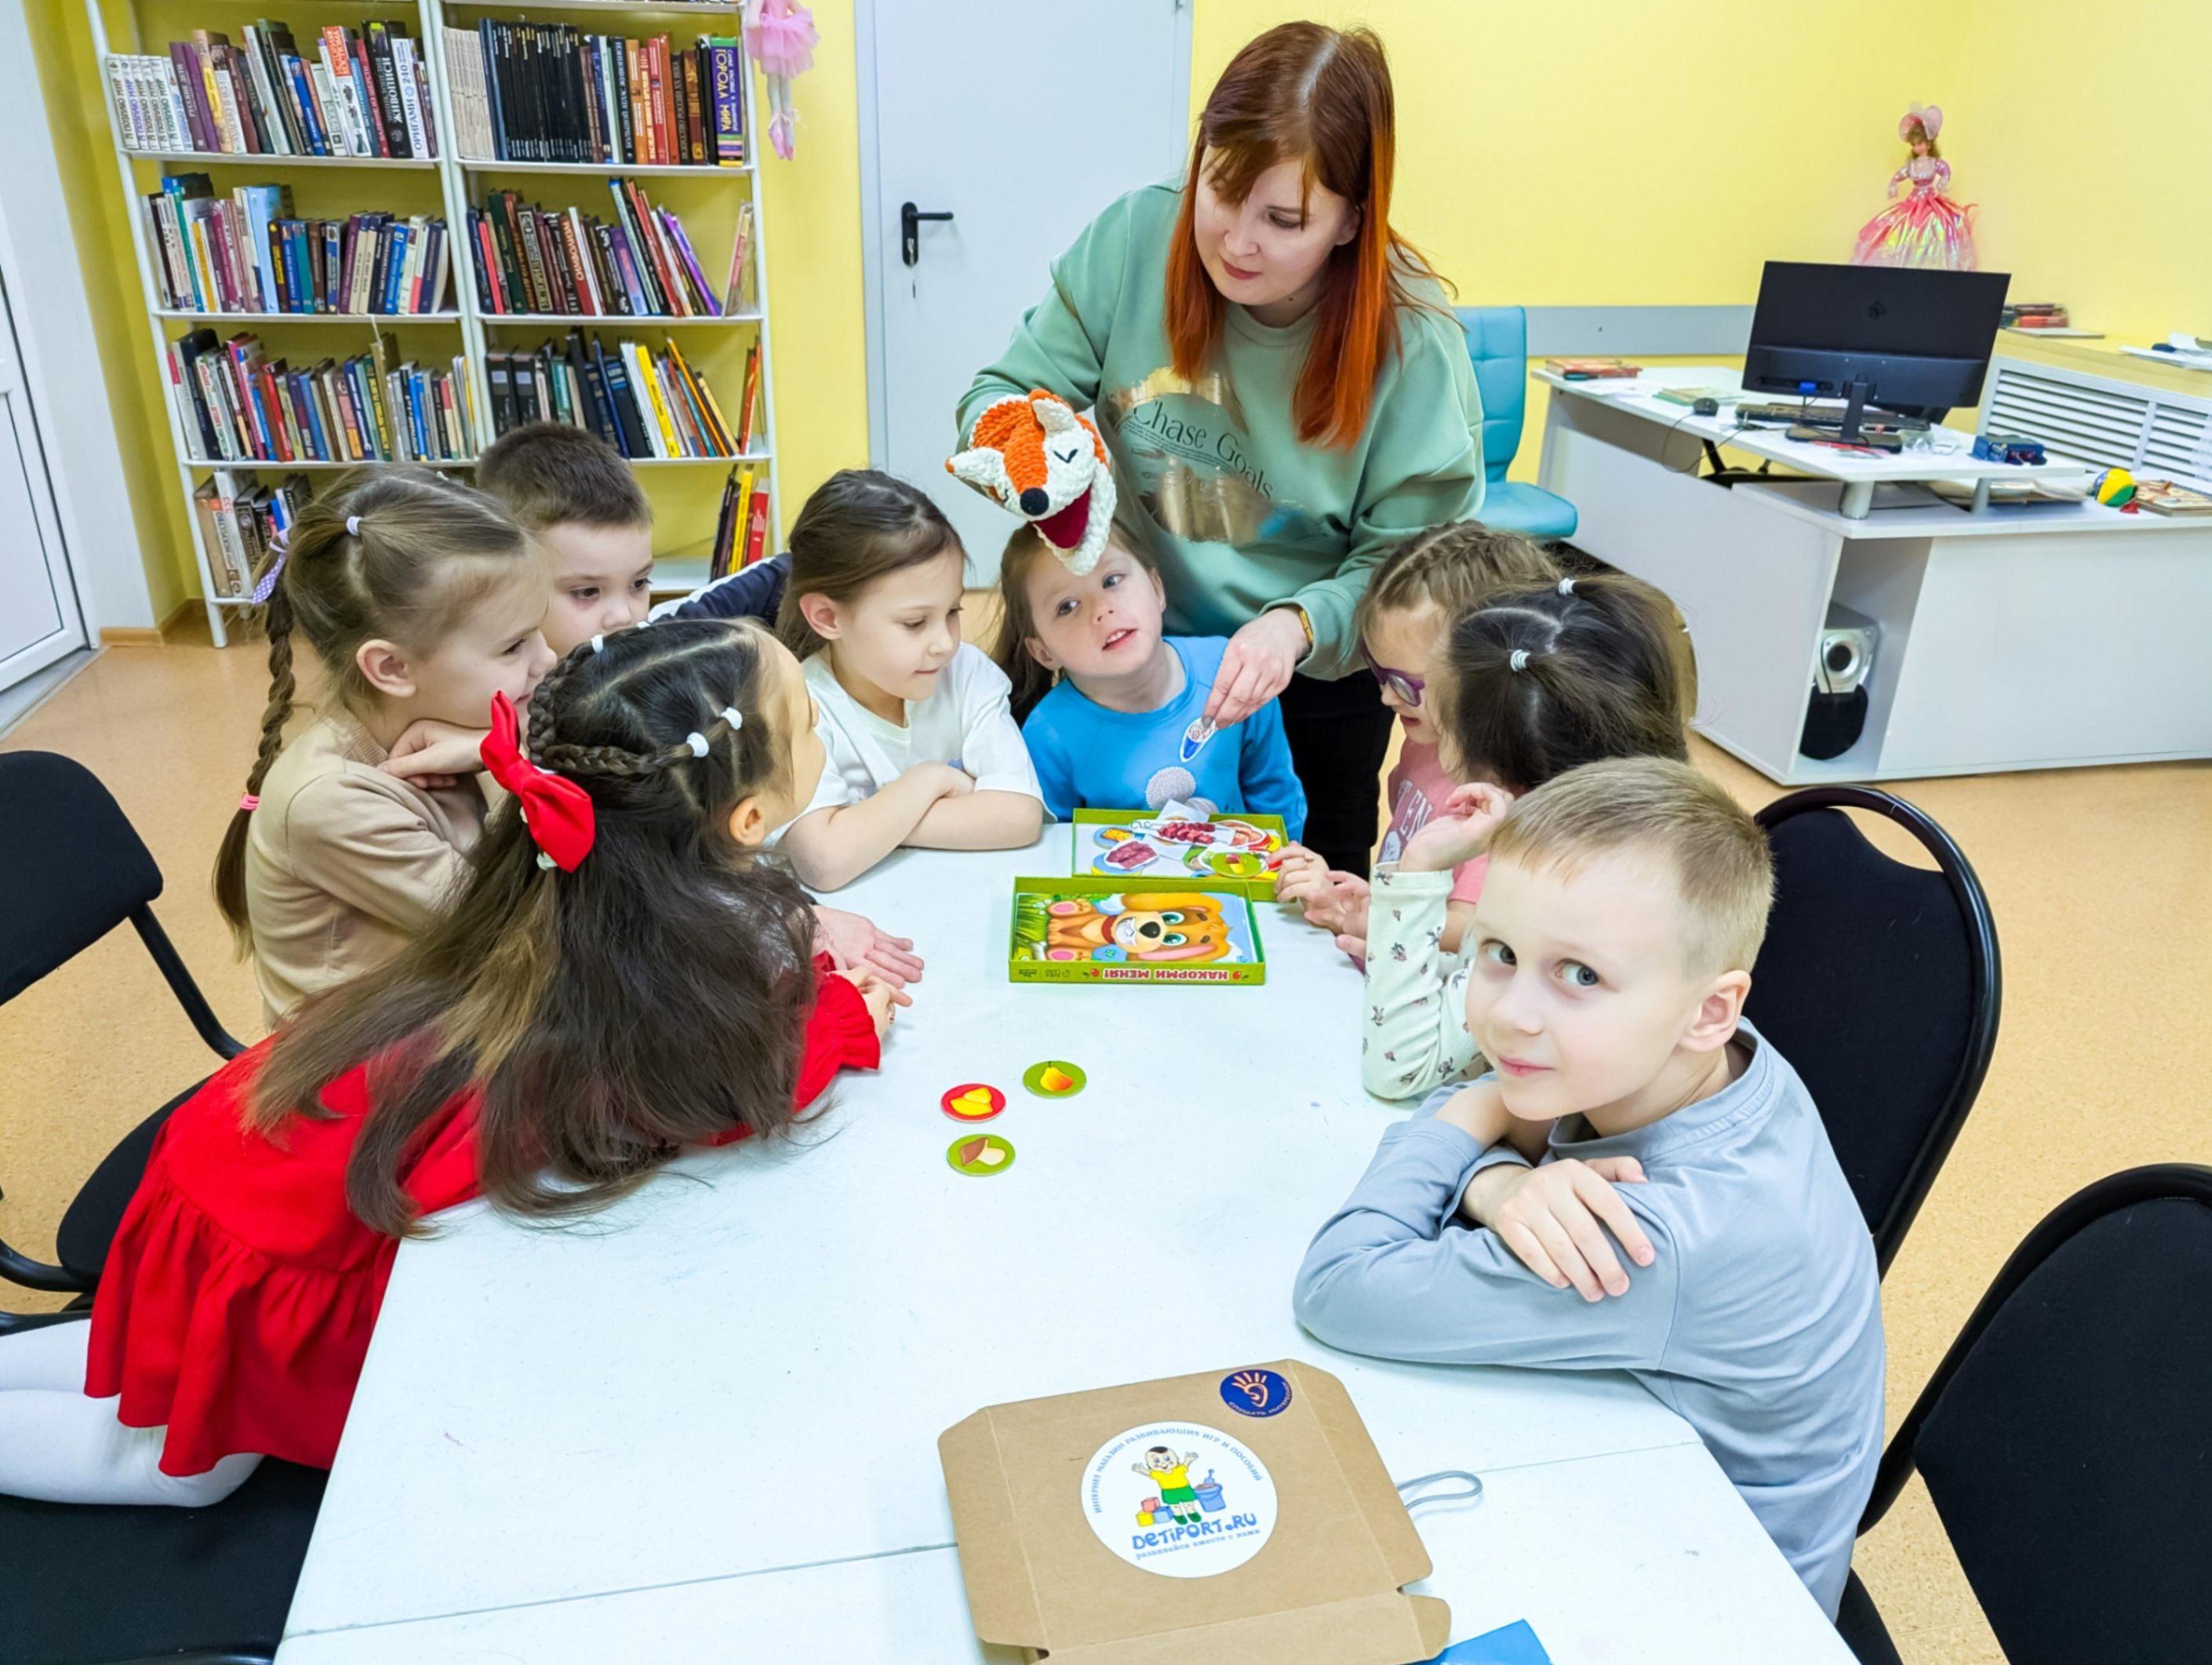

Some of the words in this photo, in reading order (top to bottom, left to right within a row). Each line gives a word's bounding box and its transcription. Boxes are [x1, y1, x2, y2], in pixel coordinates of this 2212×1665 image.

[176, 64, 187, 83] ДЕТИ
[363, 65, 375, 96] ШЕРСТИ
[401, 64, 411, 84] 240
[615, 42, 626, 86] ЖИВОПИСИ
[715, 49, 728, 99] ГОРОДА
[113, 78, 124, 96] МИР
[126, 78, 136, 97] МИР
[156, 78, 167, 96] МИР
[182, 85, 195, 117] РУССКИЕ
[381, 56, 403, 123] ЖИВОПИСИ
[118, 98, 132, 132] ПОЗНАЮ
[130, 99, 144, 133] ПОЗНАЮ
[162, 98, 175, 132] ПОЗНАЮ
[406, 99, 423, 151] ОРИГАМИ
[621, 111, 633, 149] БОЛЬШОЙ
[720, 104, 731, 131] МИРА
[563, 221, 584, 281] СИМВОЛИЗМ
[1133, 401, 1207, 449] Chase
[1217, 431, 1274, 500] Goals
[216, 511, 231, 553] ИСКУССТВО
[1104, 969, 1150, 980] МЕНЯ!
[1155, 969, 1228, 980] НАКОРМИ
[1091, 1474, 1101, 1514] ИНТЕРНЕТ
[1097, 1443, 1126, 1472] МАГАЗИН
[1125, 1427, 1200, 1447] РАЗВИВАЮЩИХ
[1202, 1432, 1221, 1443] ИГР
[1221, 1441, 1231, 1449] И
[1230, 1445, 1263, 1481] ПОСОБИЙ
[1136, 1543, 1190, 1560] развивайся
[1192, 1536, 1226, 1547] вместе
[1236, 1528, 1261, 1540] нами
